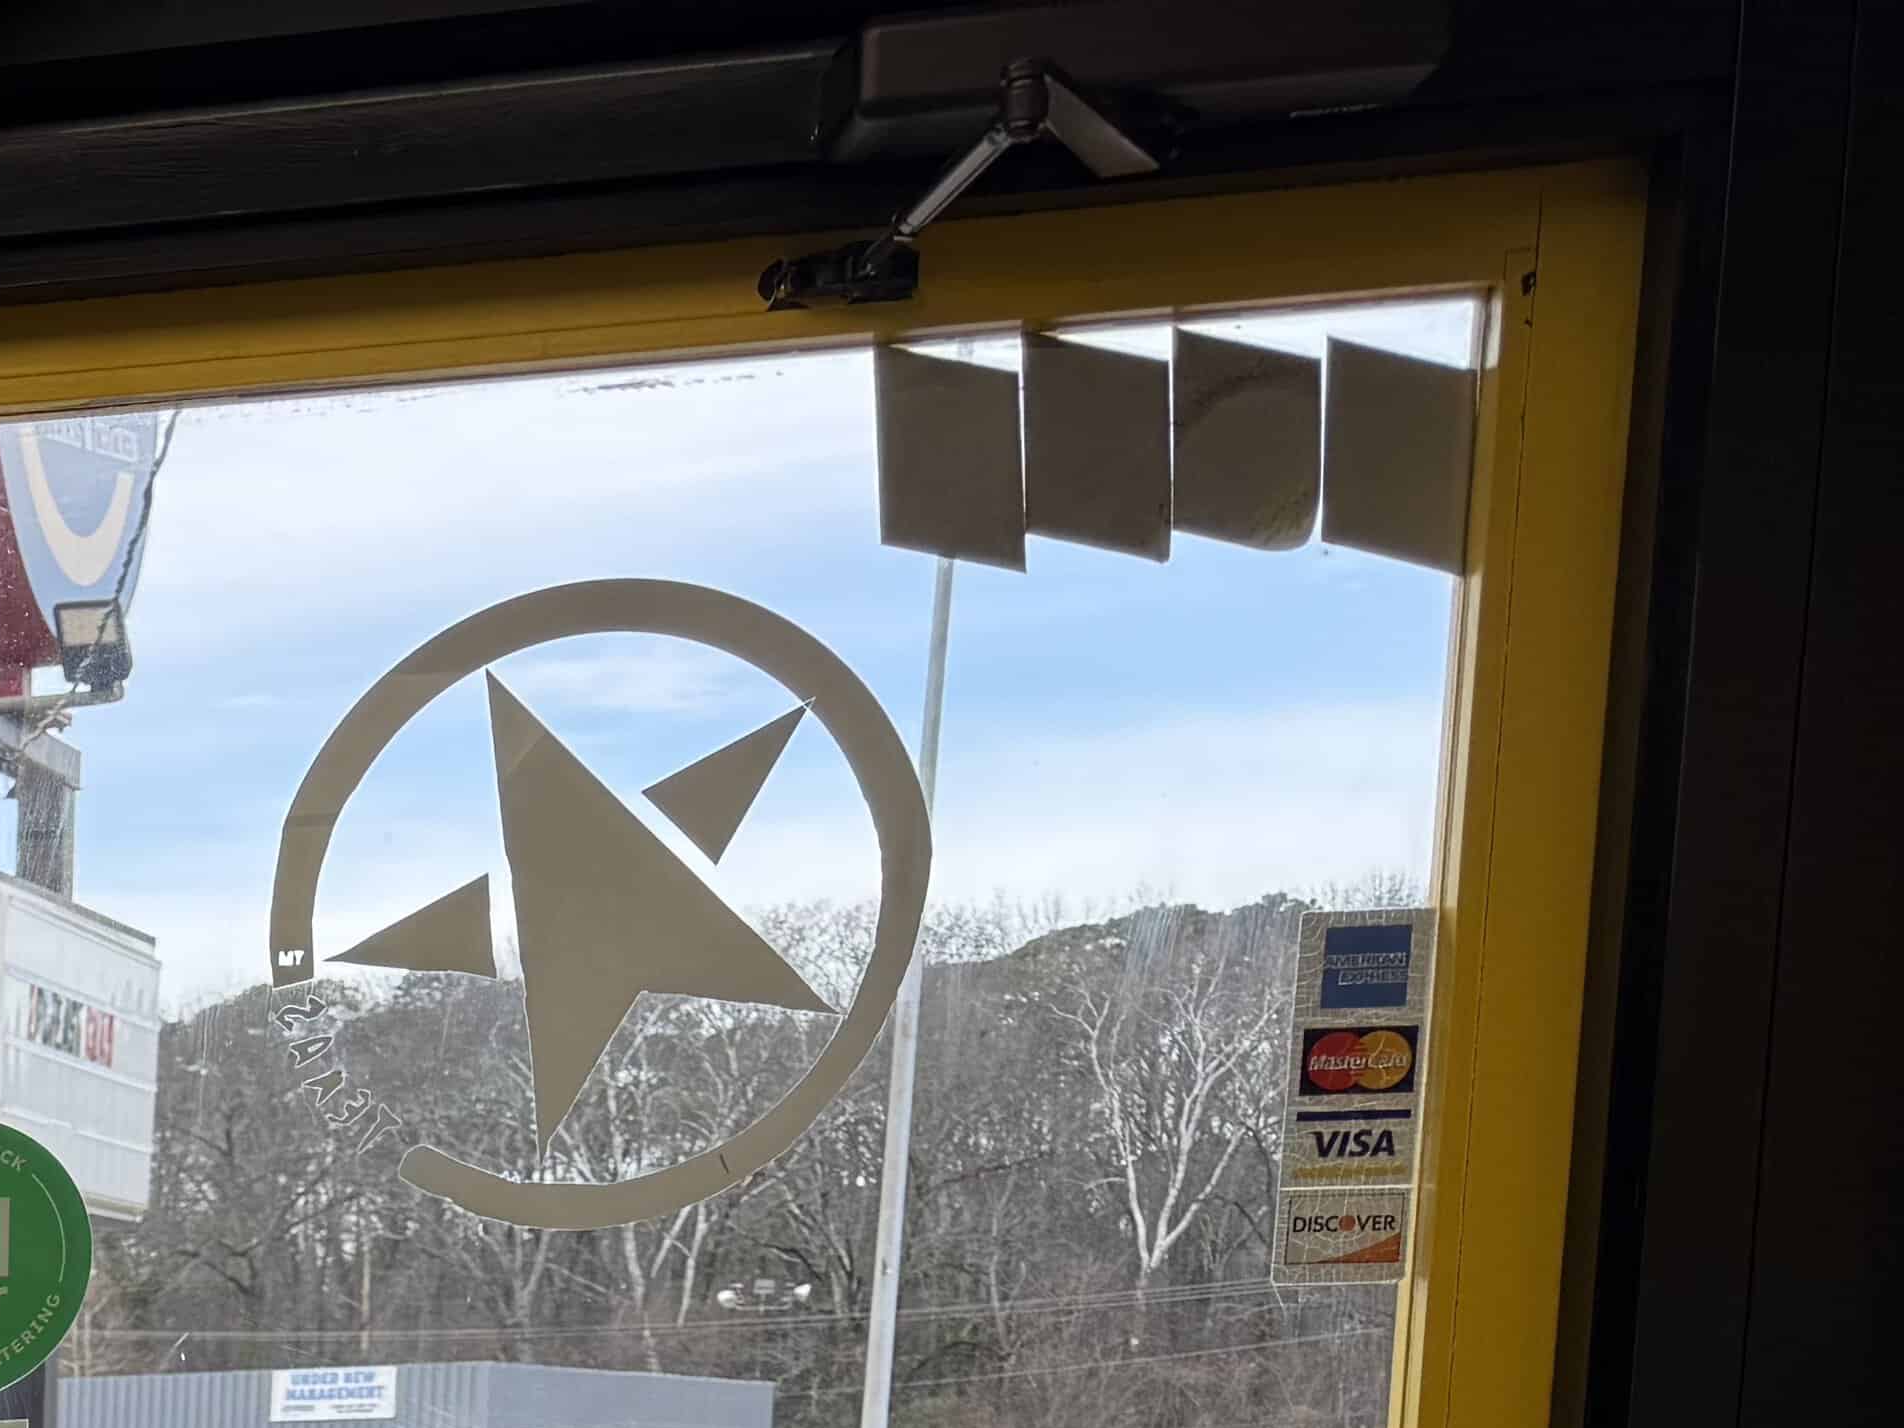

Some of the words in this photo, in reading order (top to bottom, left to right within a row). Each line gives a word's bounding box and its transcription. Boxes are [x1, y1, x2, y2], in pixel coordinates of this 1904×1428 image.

[1307, 1054, 1407, 1073] MasterCard
[1310, 1129, 1396, 1158] VISA
[1292, 1213, 1396, 1234] DISCOVER
[289, 1371, 339, 1385] UNDER
[343, 1370, 376, 1384] NEW
[286, 1384, 385, 1400] MANAGEMENT
